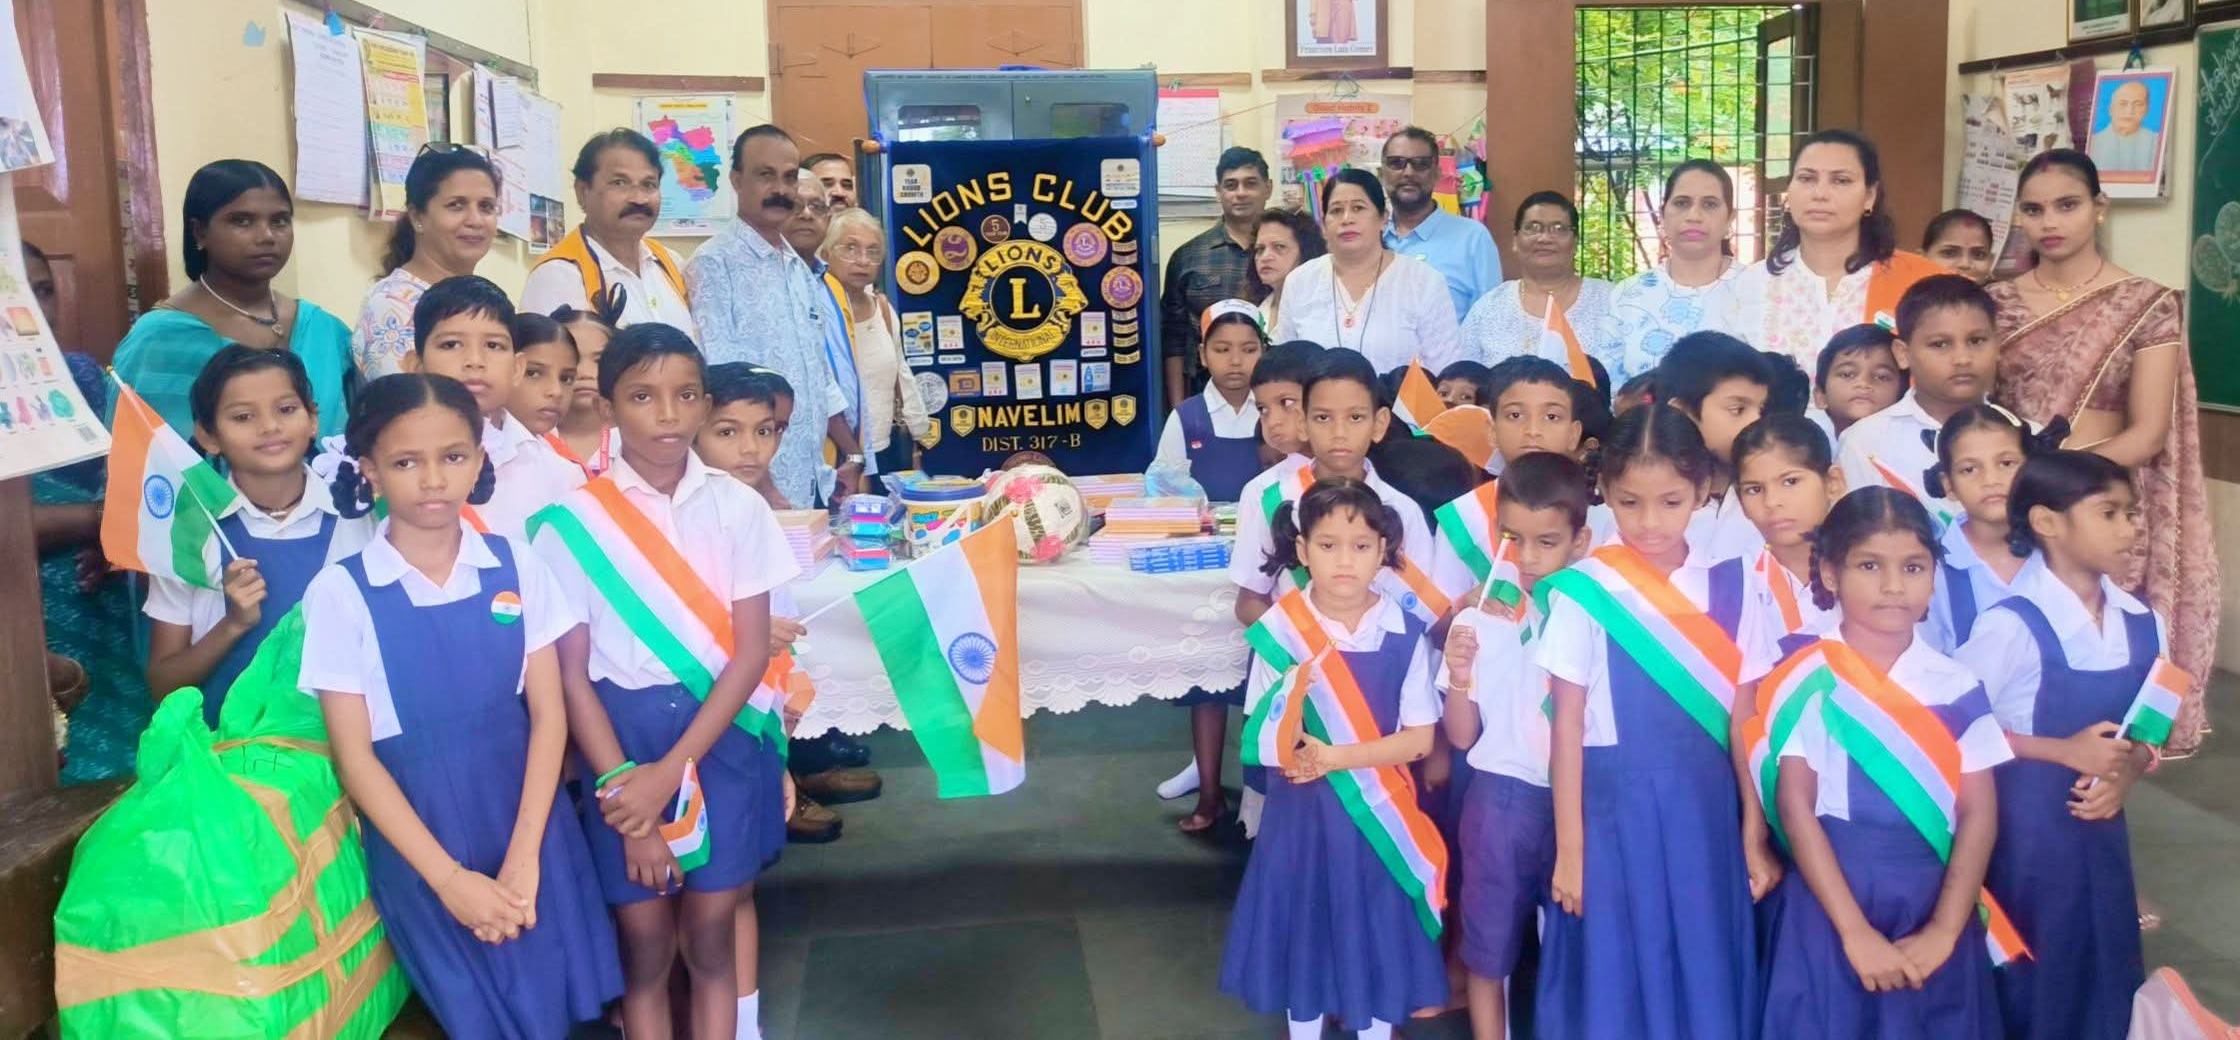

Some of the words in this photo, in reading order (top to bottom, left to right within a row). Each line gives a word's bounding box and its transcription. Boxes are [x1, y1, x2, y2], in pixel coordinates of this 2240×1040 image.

[902, 171, 1013, 248] LIONS
[1032, 173, 1133, 242] CLUB
[991, 218, 1001, 232] 5
[983, 245, 1057, 273] LIONS
[1008, 277, 1042, 319] L
[977, 402, 1081, 429] NAVELIM
[982, 435, 1024, 452] DIST.
